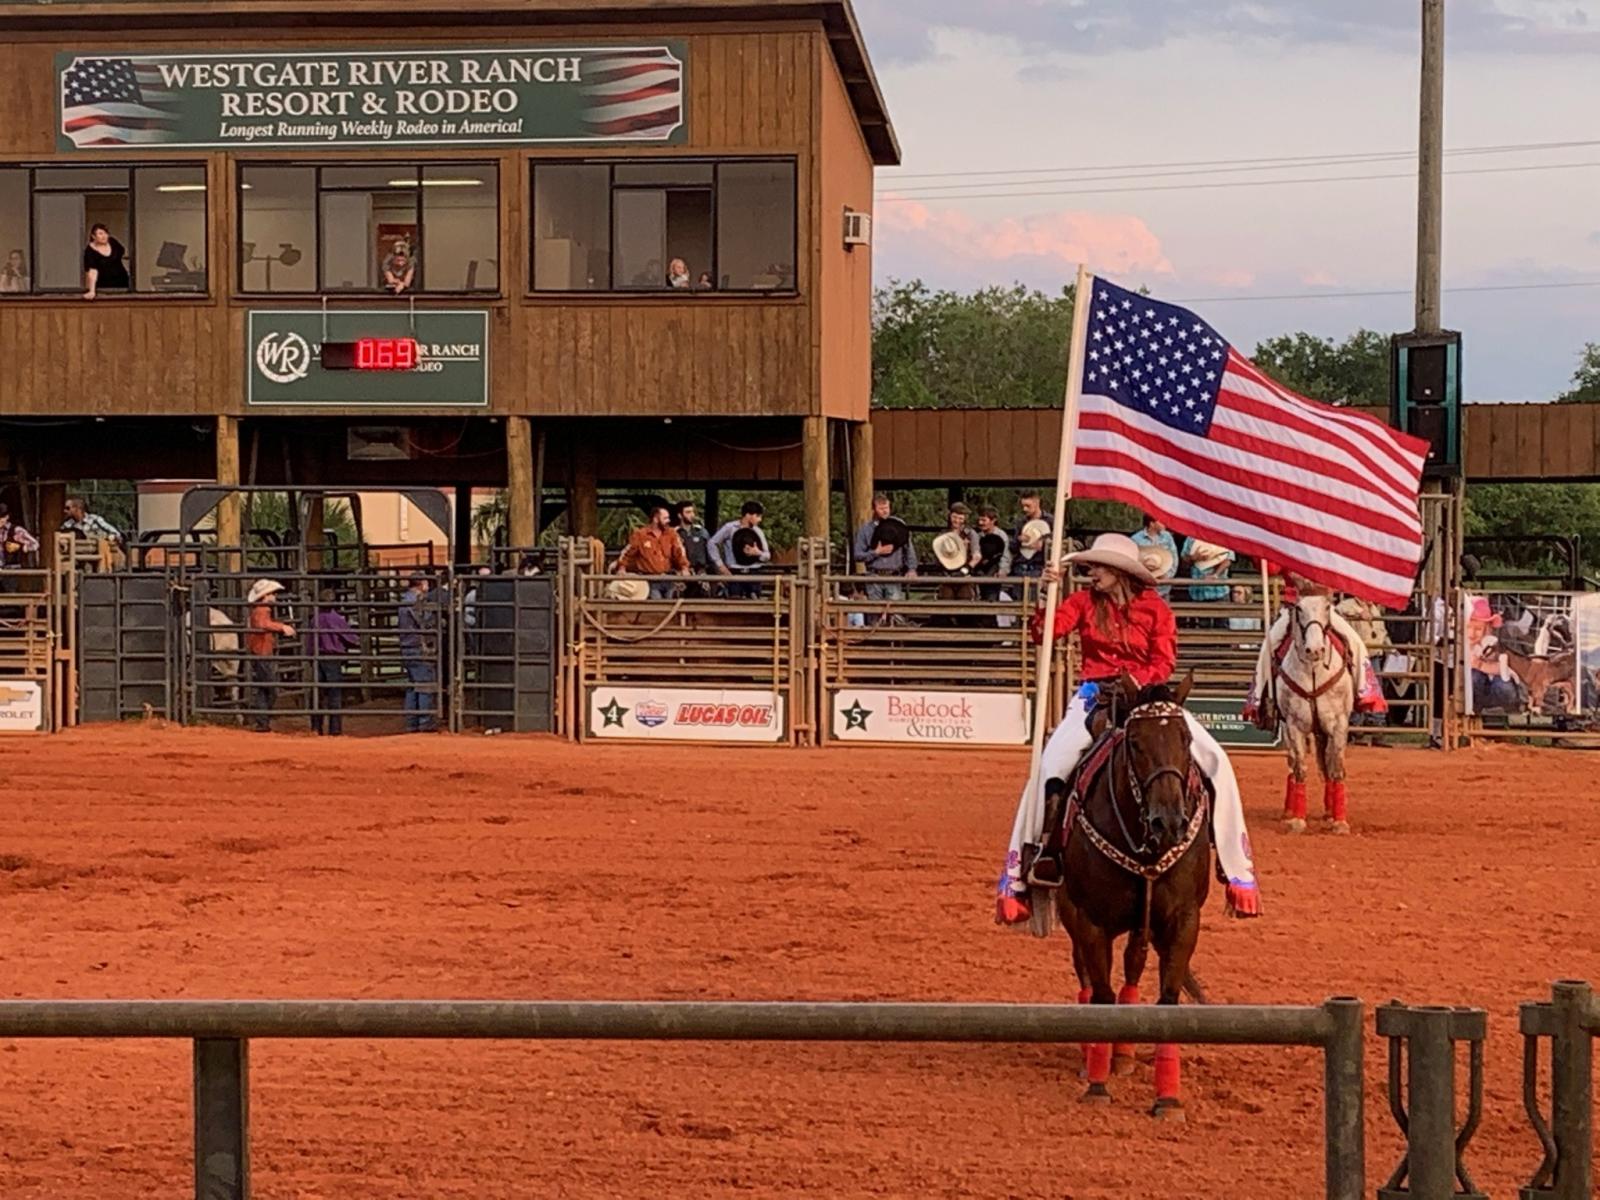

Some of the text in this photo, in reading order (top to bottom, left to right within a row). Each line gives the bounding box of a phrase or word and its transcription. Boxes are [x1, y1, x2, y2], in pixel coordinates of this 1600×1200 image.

[157, 57, 582, 88] WESTGATE RIVER RANCH
[220, 88, 519, 117] RESORT & RODEO
[219, 118, 523, 141] Longest Running Weekly Rodeo in America!
[357, 339, 413, 368] 069
[431, 343, 480, 356] RANCH
[607, 704, 619, 723] 4
[676, 703, 738, 725] LUCAS
[738, 704, 773, 726] OIL
[850, 708, 862, 725] 5
[887, 695, 974, 718] Badcock
[906, 716, 974, 739] &more
